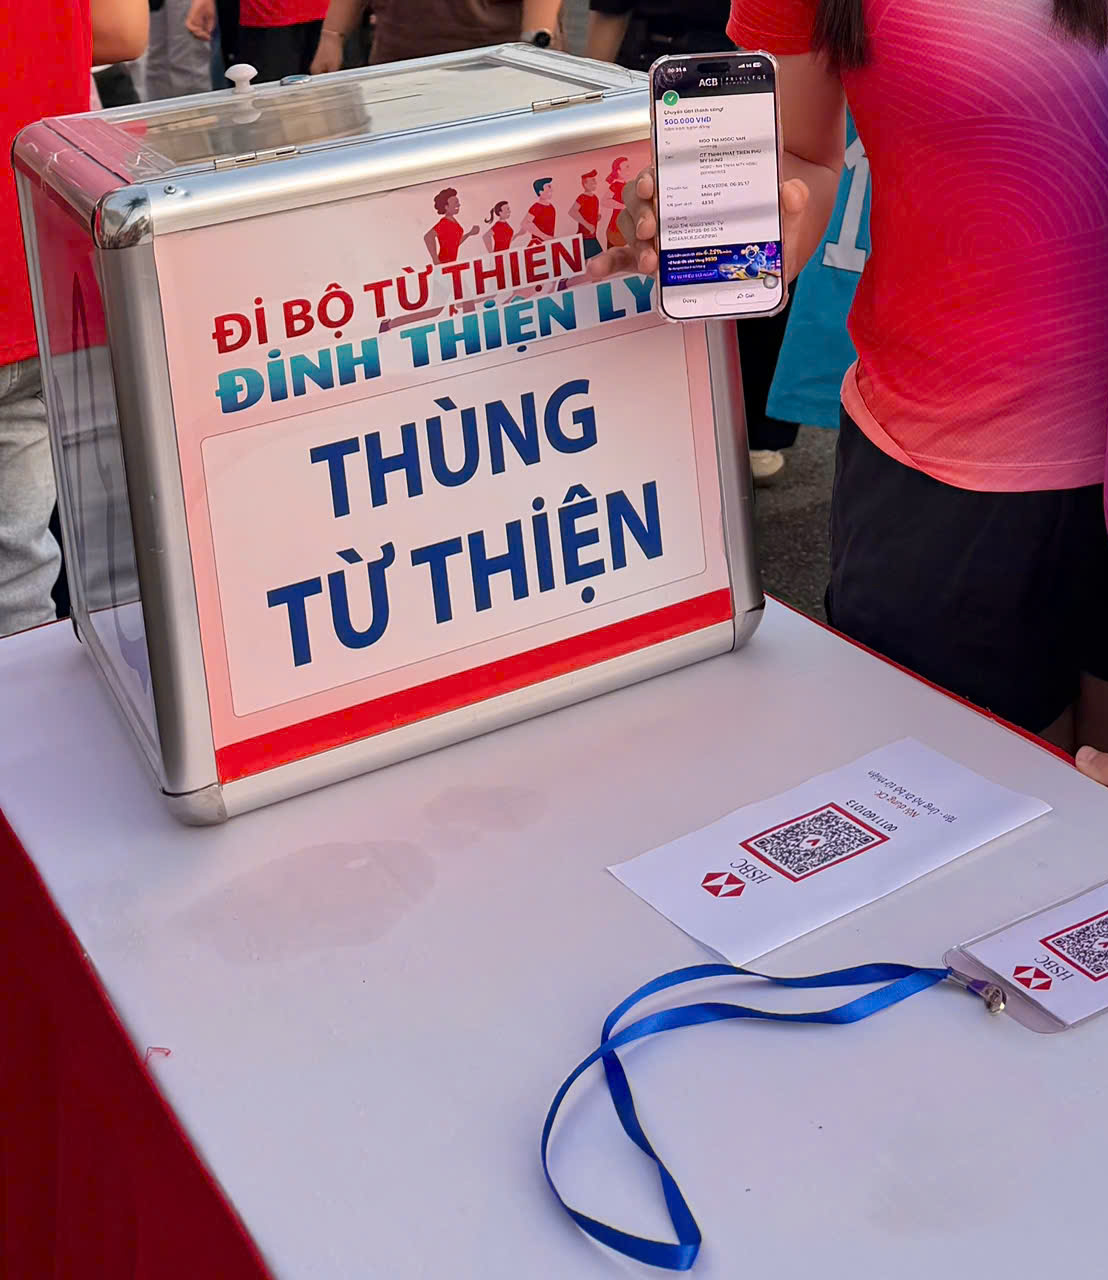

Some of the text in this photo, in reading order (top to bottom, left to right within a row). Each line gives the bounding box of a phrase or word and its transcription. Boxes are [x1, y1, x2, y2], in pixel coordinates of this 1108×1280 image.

[698, 77, 718, 87] ACB
[283, 282, 355, 339] BỘ
[364, 265, 434, 319] TỪ
[441, 235, 585, 302] THIỆN
[400, 290, 577, 368] THIỆN
[310, 379, 598, 518] THÙNG
[267, 480, 664, 668] TỪ THIỆN
[729, 857, 774, 885] HSBC
[1033, 953, 1075, 982] HSBC
